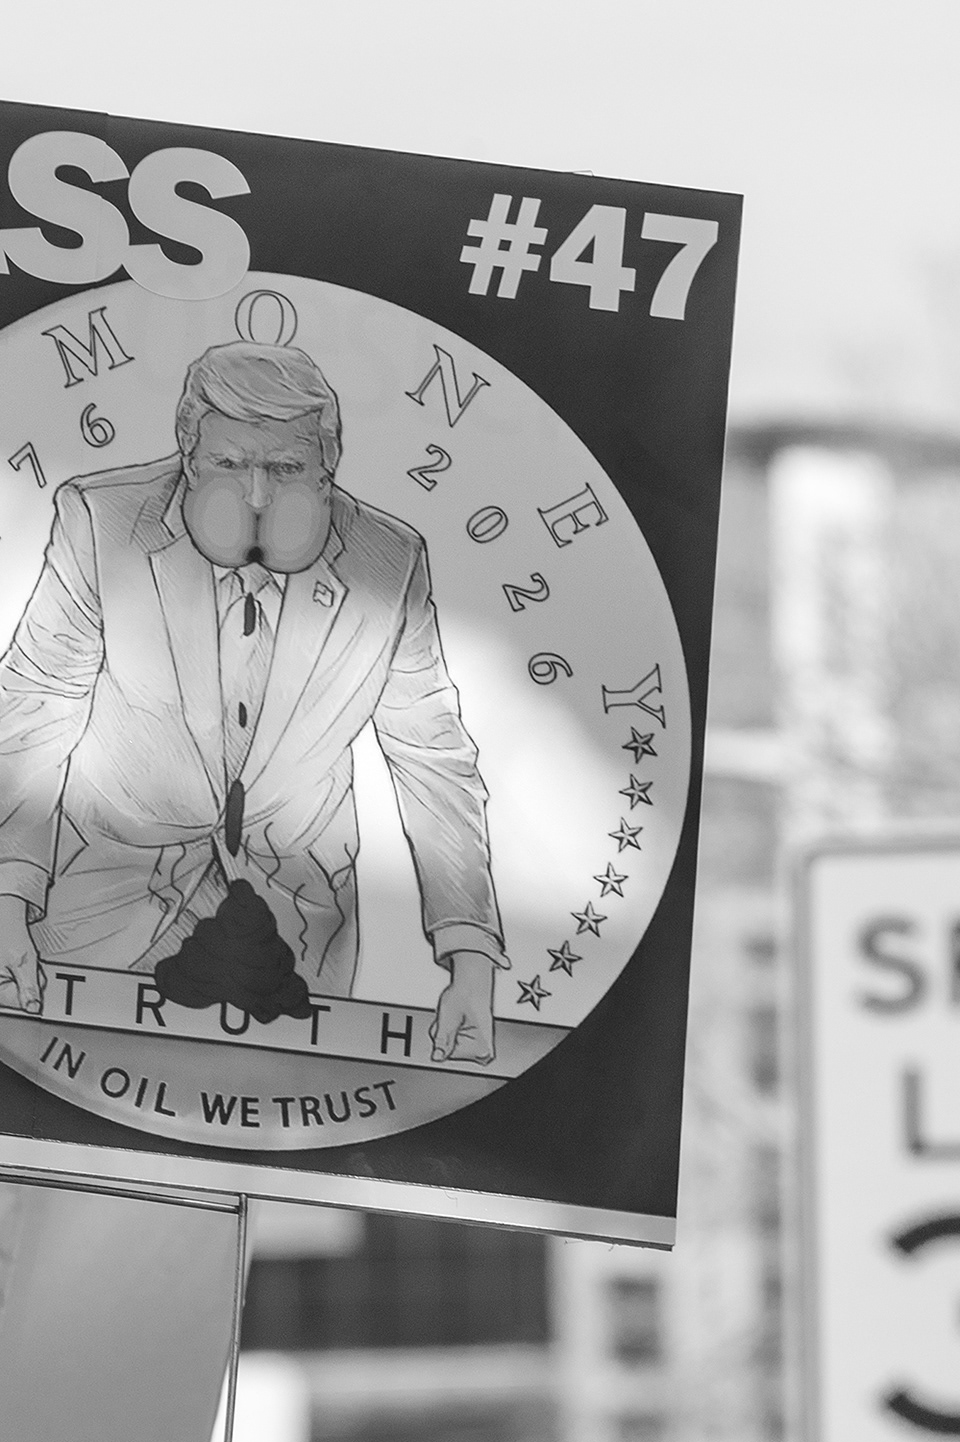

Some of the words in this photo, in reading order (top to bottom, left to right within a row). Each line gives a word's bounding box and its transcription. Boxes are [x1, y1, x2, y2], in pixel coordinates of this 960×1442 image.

[459, 193, 720, 320] #47
[39, 1036, 86, 1079] IN
[100, 1066, 176, 1117] OIL
[200, 1091, 261, 1128] WE
[272, 1079, 397, 1128] TRUST
